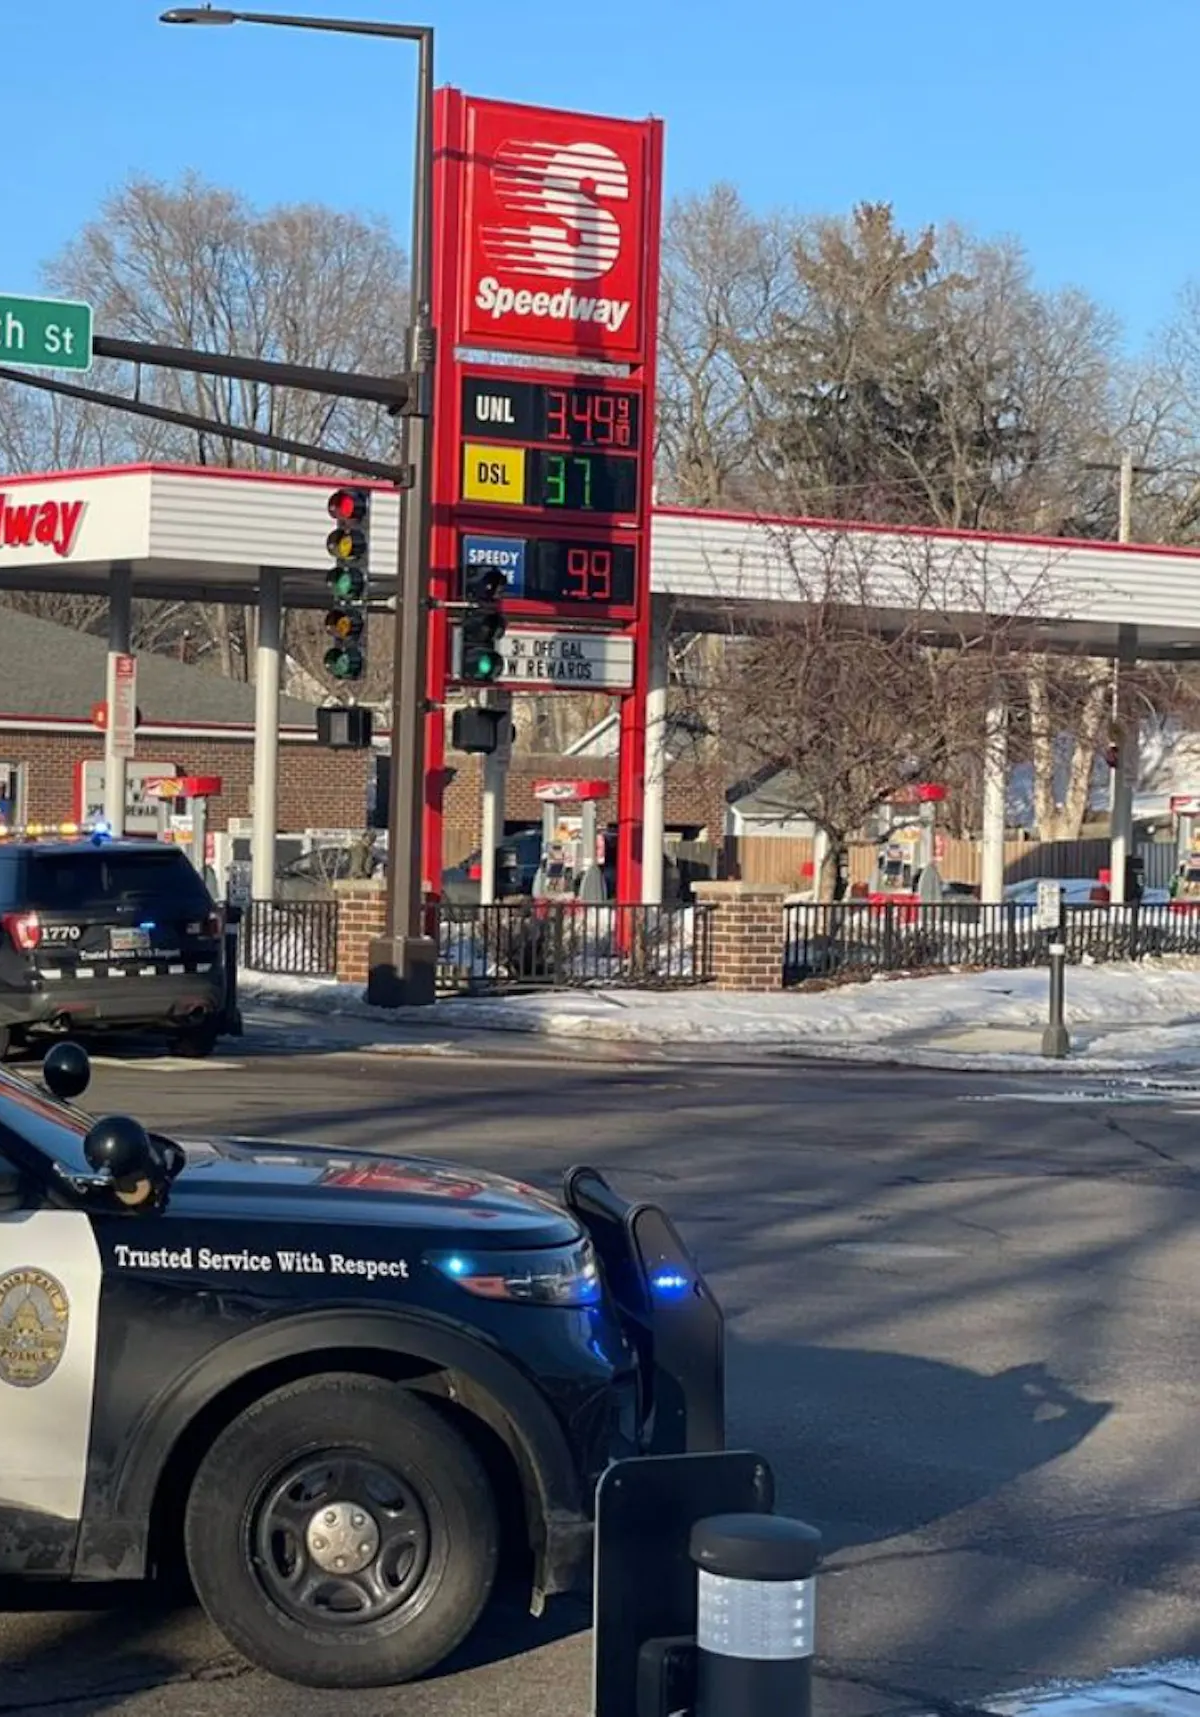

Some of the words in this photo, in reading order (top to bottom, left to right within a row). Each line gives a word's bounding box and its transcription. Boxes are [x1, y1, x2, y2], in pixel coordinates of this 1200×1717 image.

[475, 276, 630, 332] Speedway
[44, 323, 75, 355] St
[475, 395, 516, 424] UNL
[477, 462, 511, 486] DSL
[468, 548, 520, 566] SPEEDY
[532, 640, 554, 658] OFF
[560, 641, 586, 660] GAL
[527, 660, 593, 680] REWARDS
[41, 926, 80, 941] 1770
[114, 1243, 194, 1269] Trusted
[198, 1247, 272, 1272] Service
[276, 1250, 326, 1274] With
[329, 1253, 410, 1282] Respect
